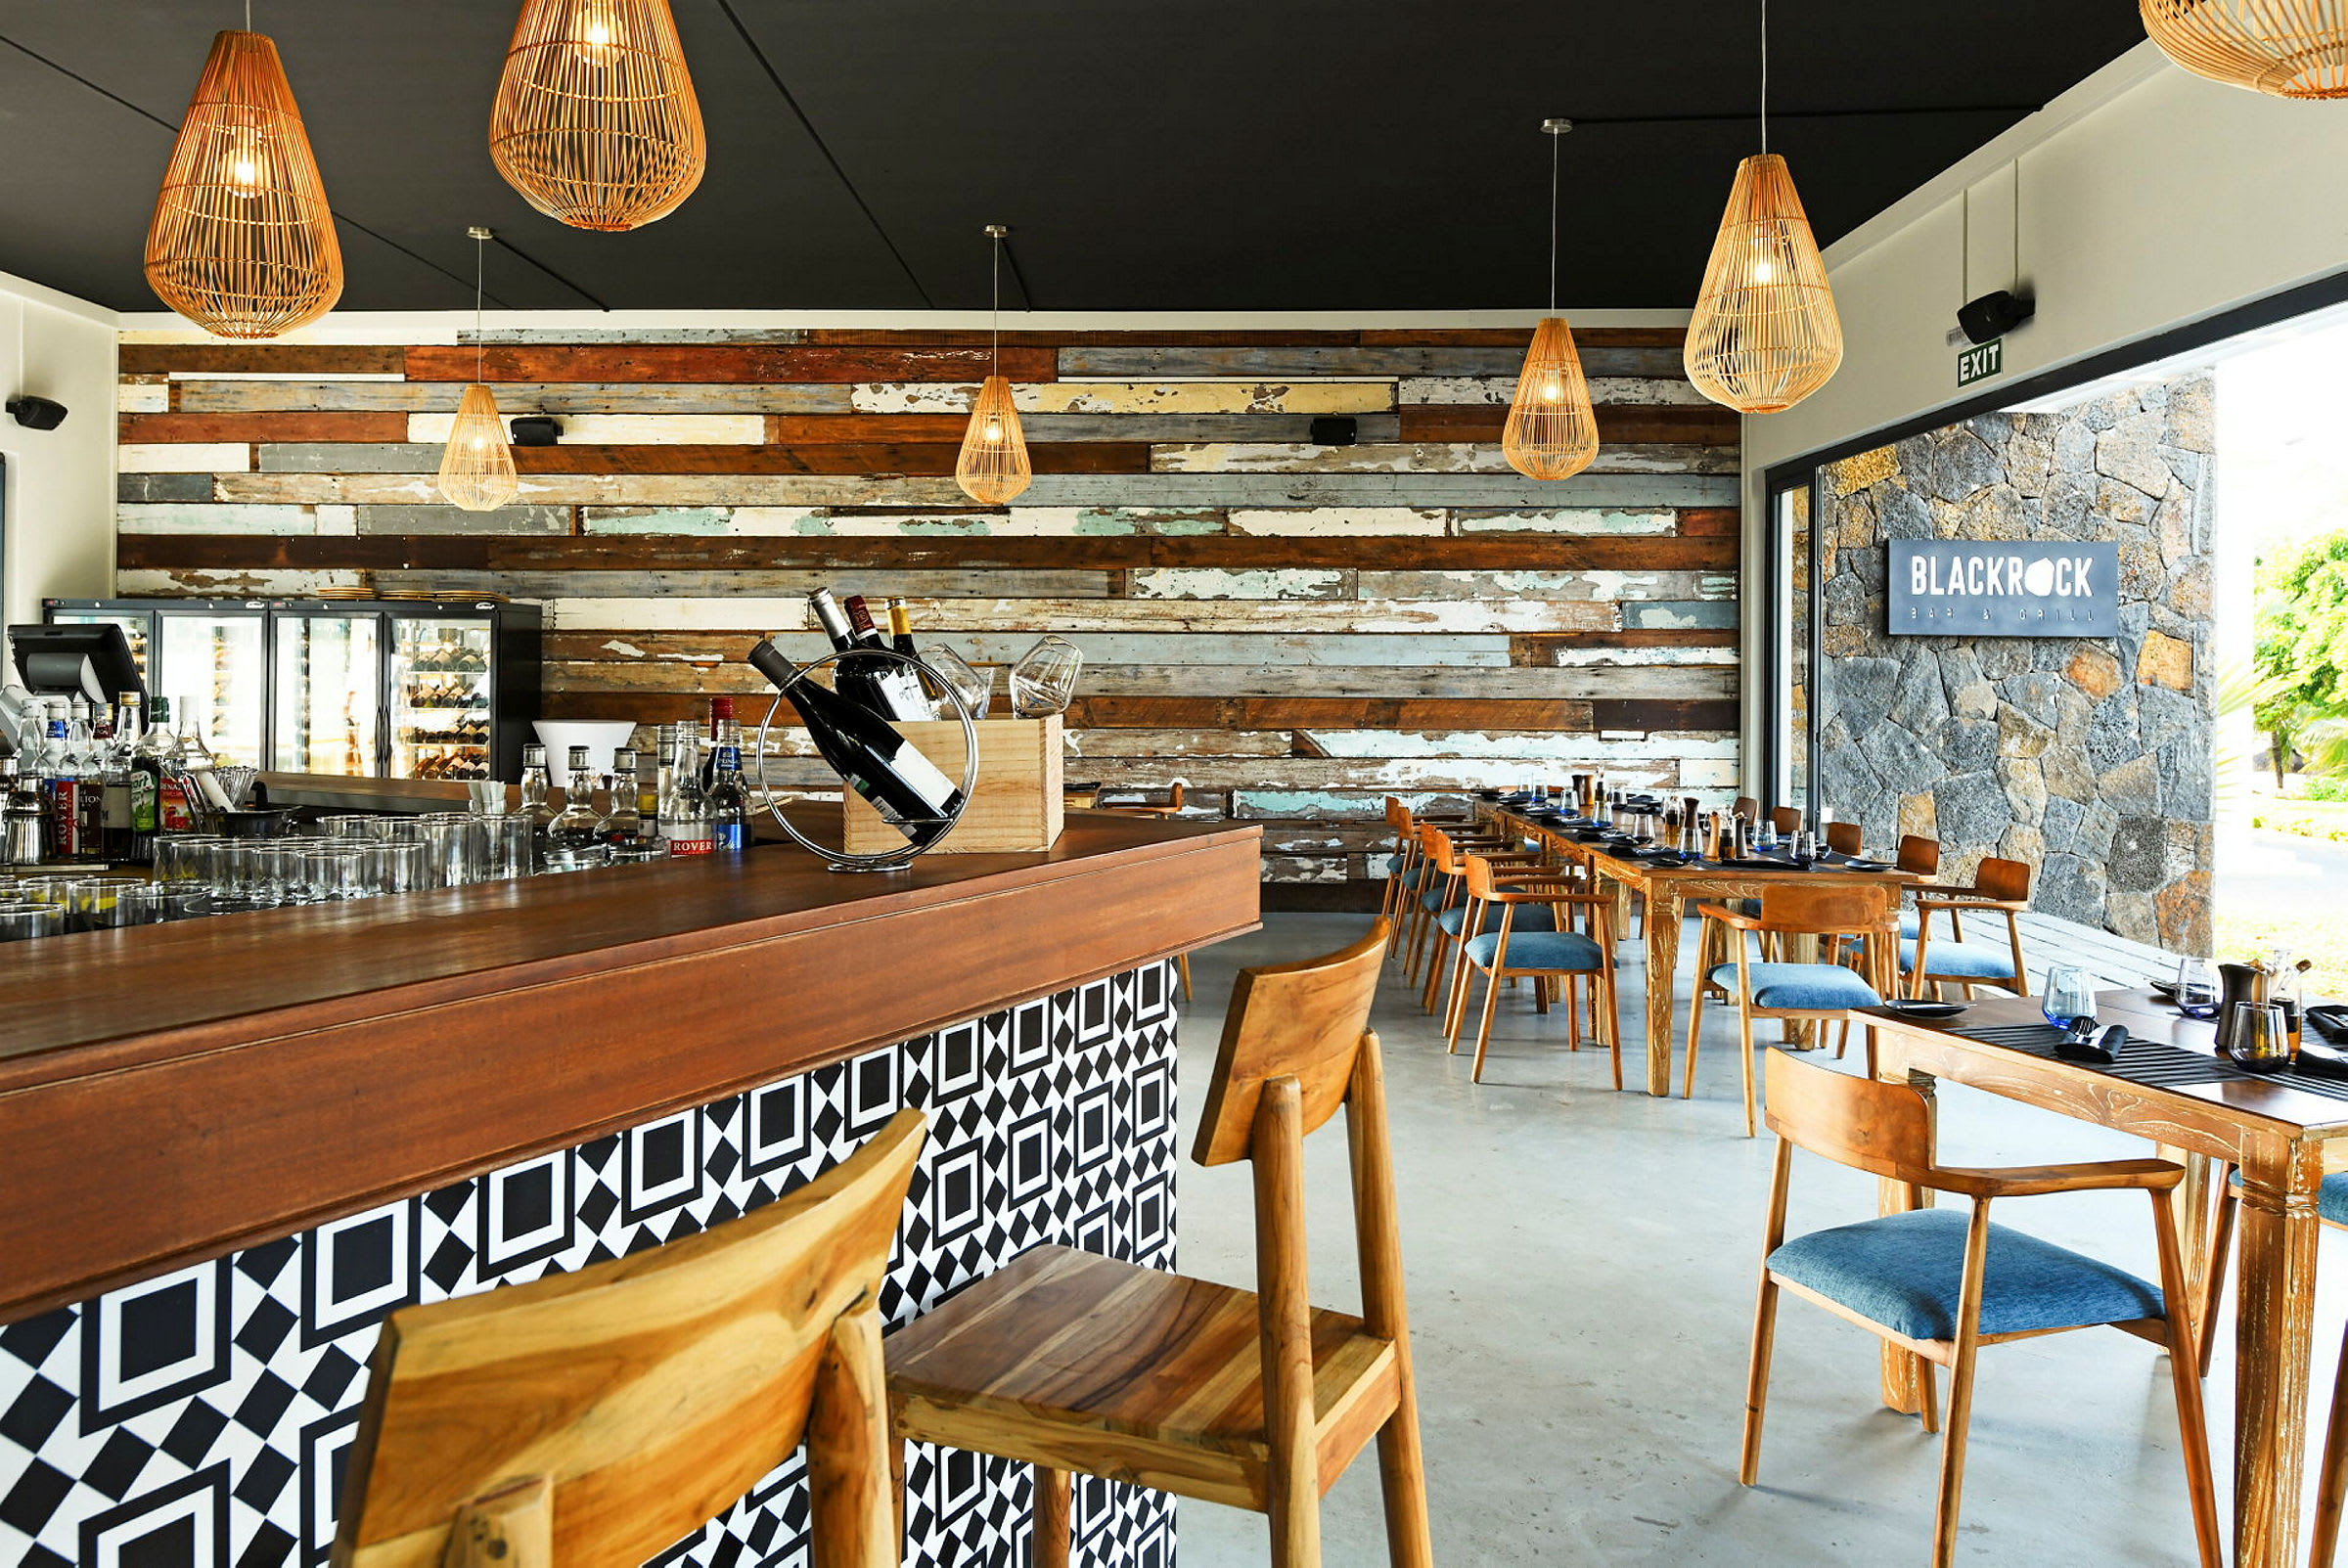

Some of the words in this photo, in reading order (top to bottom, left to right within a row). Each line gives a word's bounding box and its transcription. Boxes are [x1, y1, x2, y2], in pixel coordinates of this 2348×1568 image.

[1960, 343, 1999, 382] EXIT
[1911, 556, 2094, 598] BLACKROCK
[1911, 606, 1954, 619] BAR
[2019, 608, 2095, 621] GRILL
[673, 841, 712, 852] ROVER
